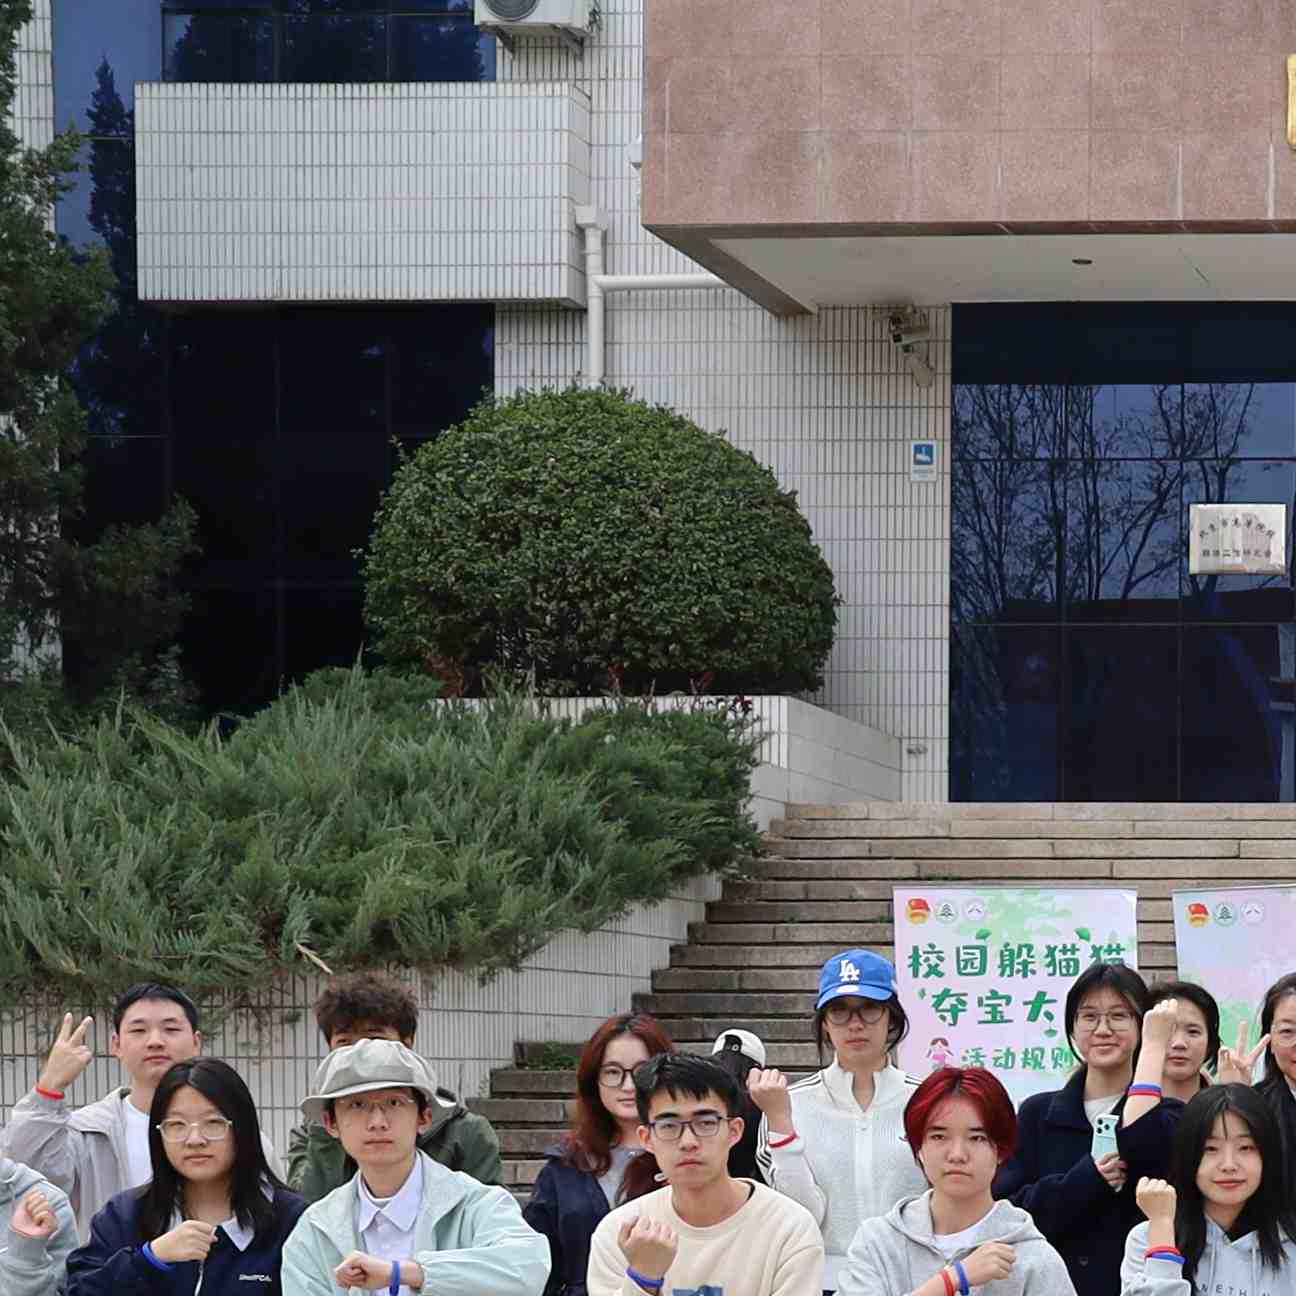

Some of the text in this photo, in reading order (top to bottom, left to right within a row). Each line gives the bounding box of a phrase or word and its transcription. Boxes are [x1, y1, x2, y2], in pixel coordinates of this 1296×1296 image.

[839, 959, 860, 982] LA
[931, 987, 1058, 1027] 夺宝大
